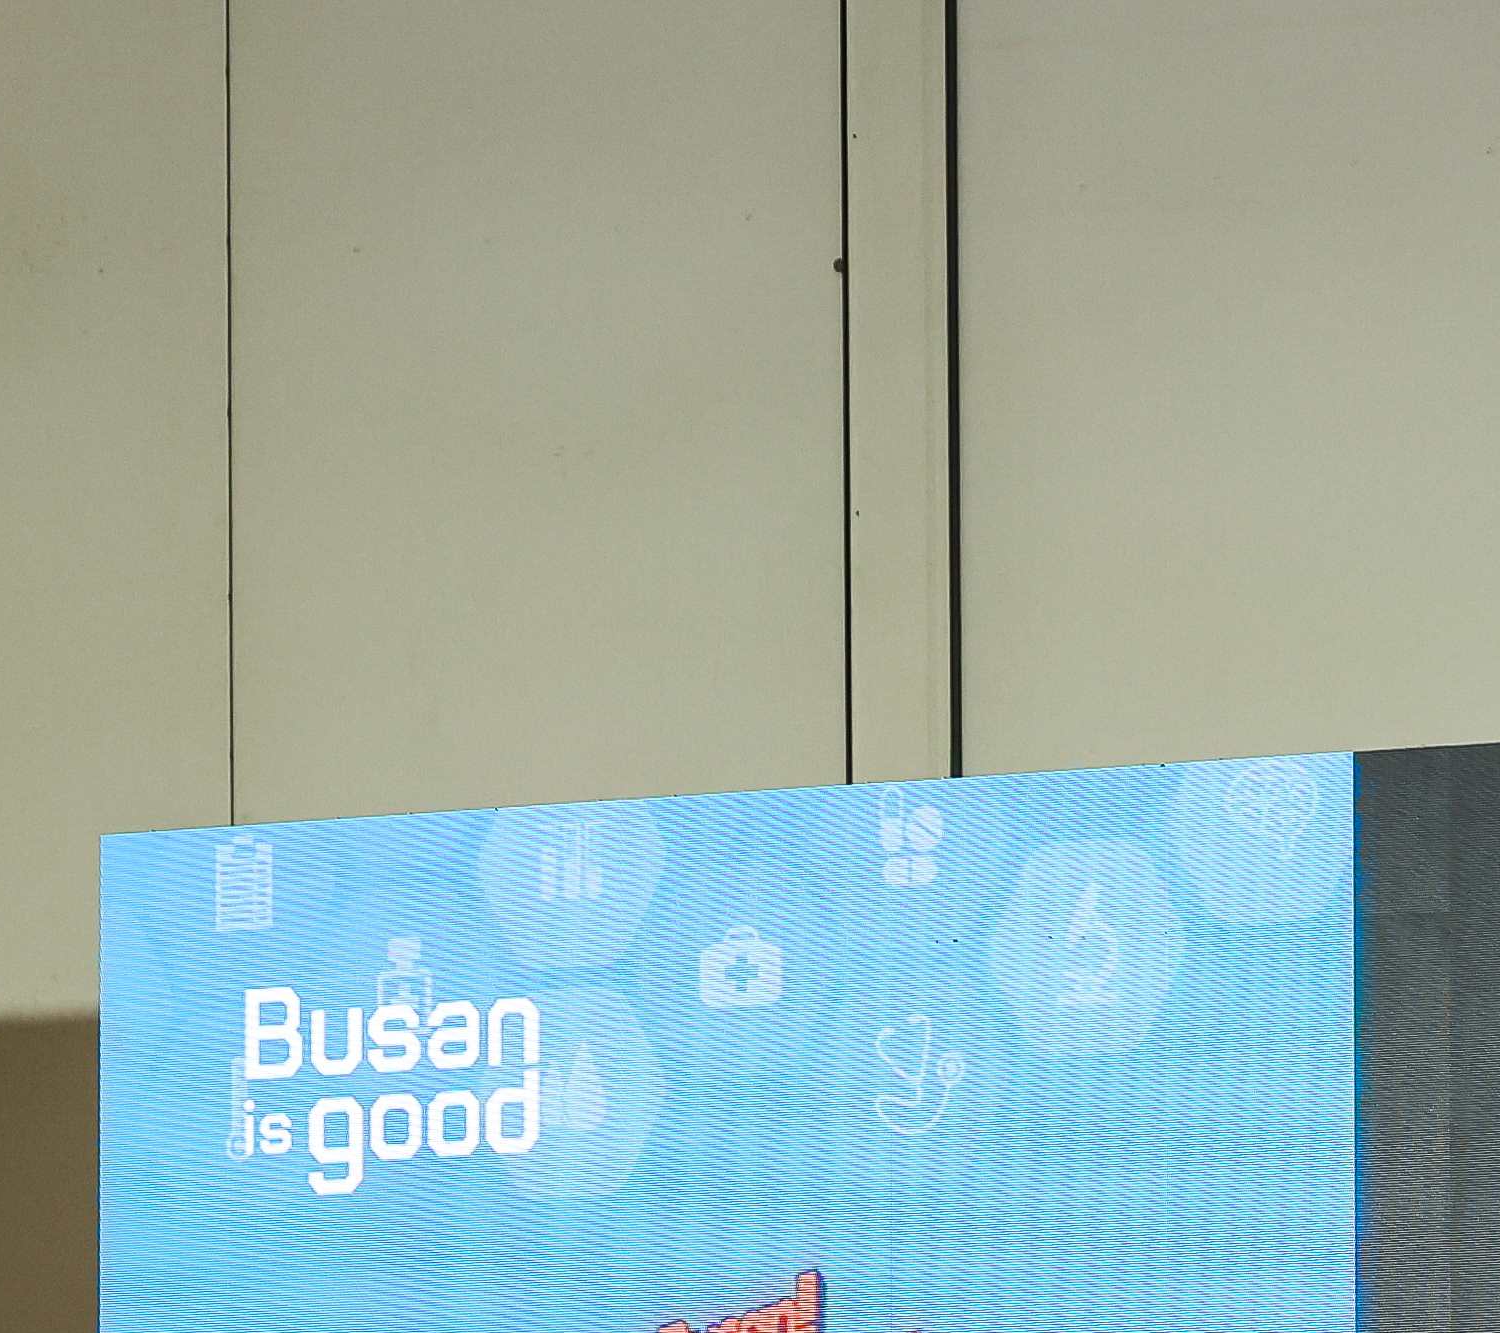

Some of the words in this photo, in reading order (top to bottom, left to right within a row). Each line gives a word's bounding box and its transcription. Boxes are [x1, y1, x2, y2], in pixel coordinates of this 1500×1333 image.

[243, 986, 542, 1080] Busan
[244, 1099, 294, 1157] is
[308, 1069, 542, 1196] good
